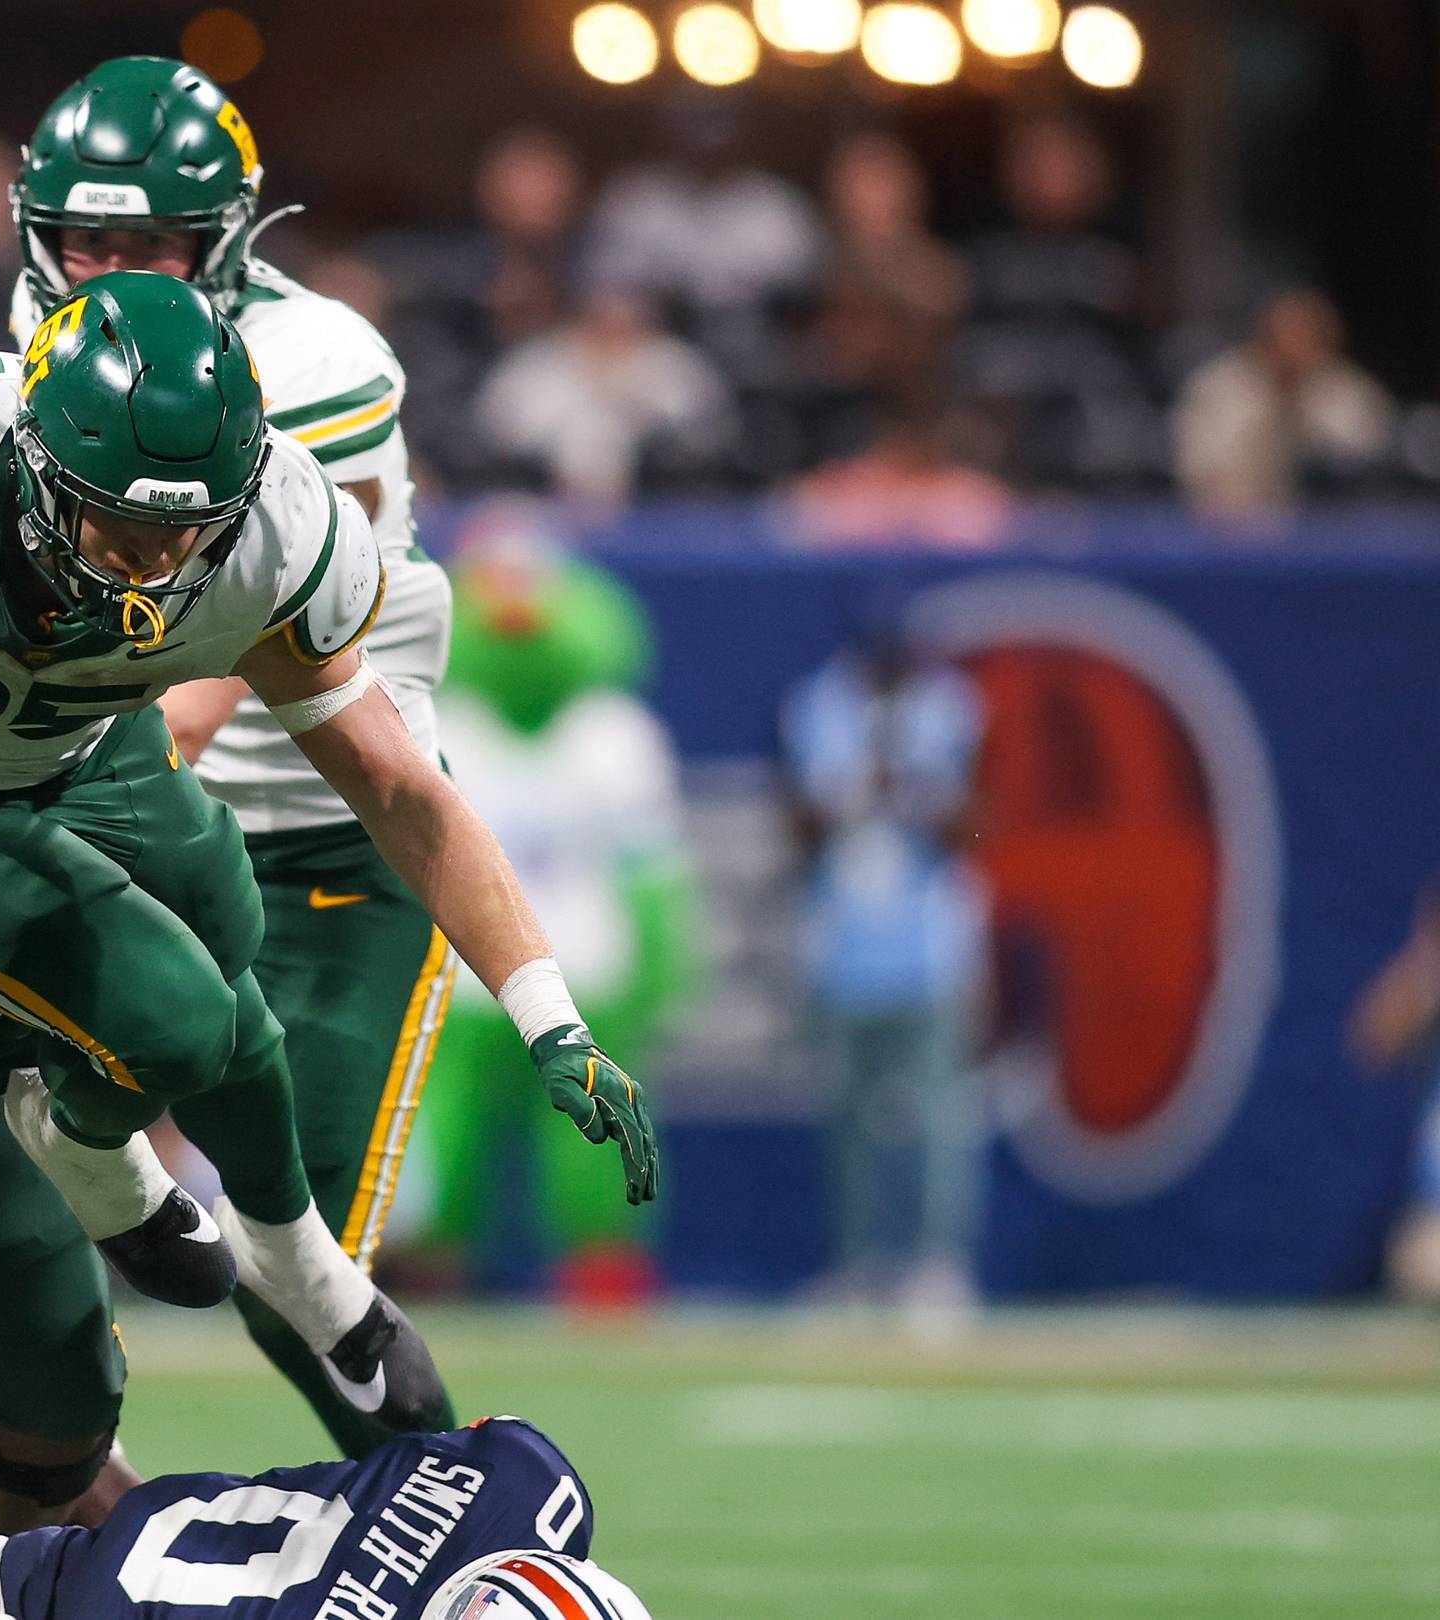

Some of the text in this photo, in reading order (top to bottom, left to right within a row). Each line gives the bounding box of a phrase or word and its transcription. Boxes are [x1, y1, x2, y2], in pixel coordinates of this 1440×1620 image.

[148, 489, 194, 504] BAYLOR
[116, 1485, 355, 1607] 0
[534, 1474, 584, 1552] 0
